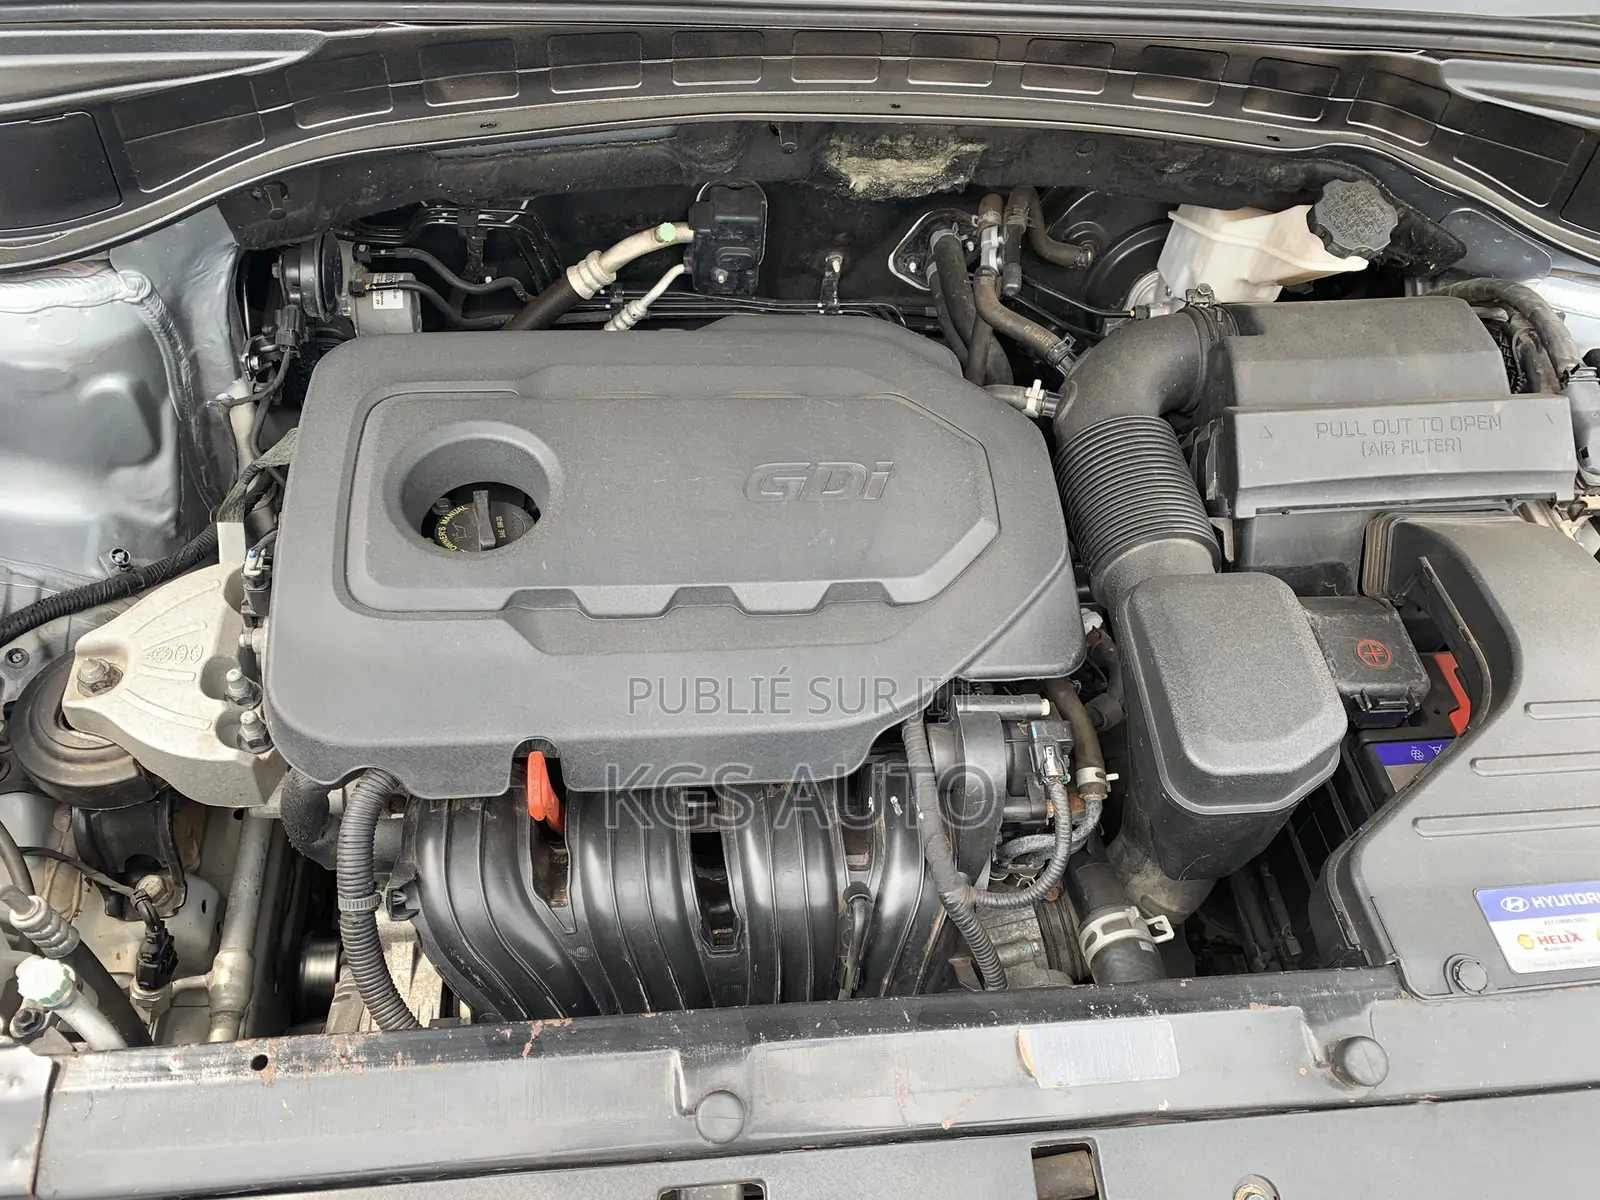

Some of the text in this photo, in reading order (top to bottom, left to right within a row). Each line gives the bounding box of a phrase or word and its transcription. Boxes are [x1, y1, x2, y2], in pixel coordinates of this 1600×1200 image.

[1315, 414, 1502, 439] PULL OUT TO OPEN
[743, 461, 894, 501] GDi
[440, 505, 469, 526] MANUAL
[1536, 930, 1587, 946] HELIX
